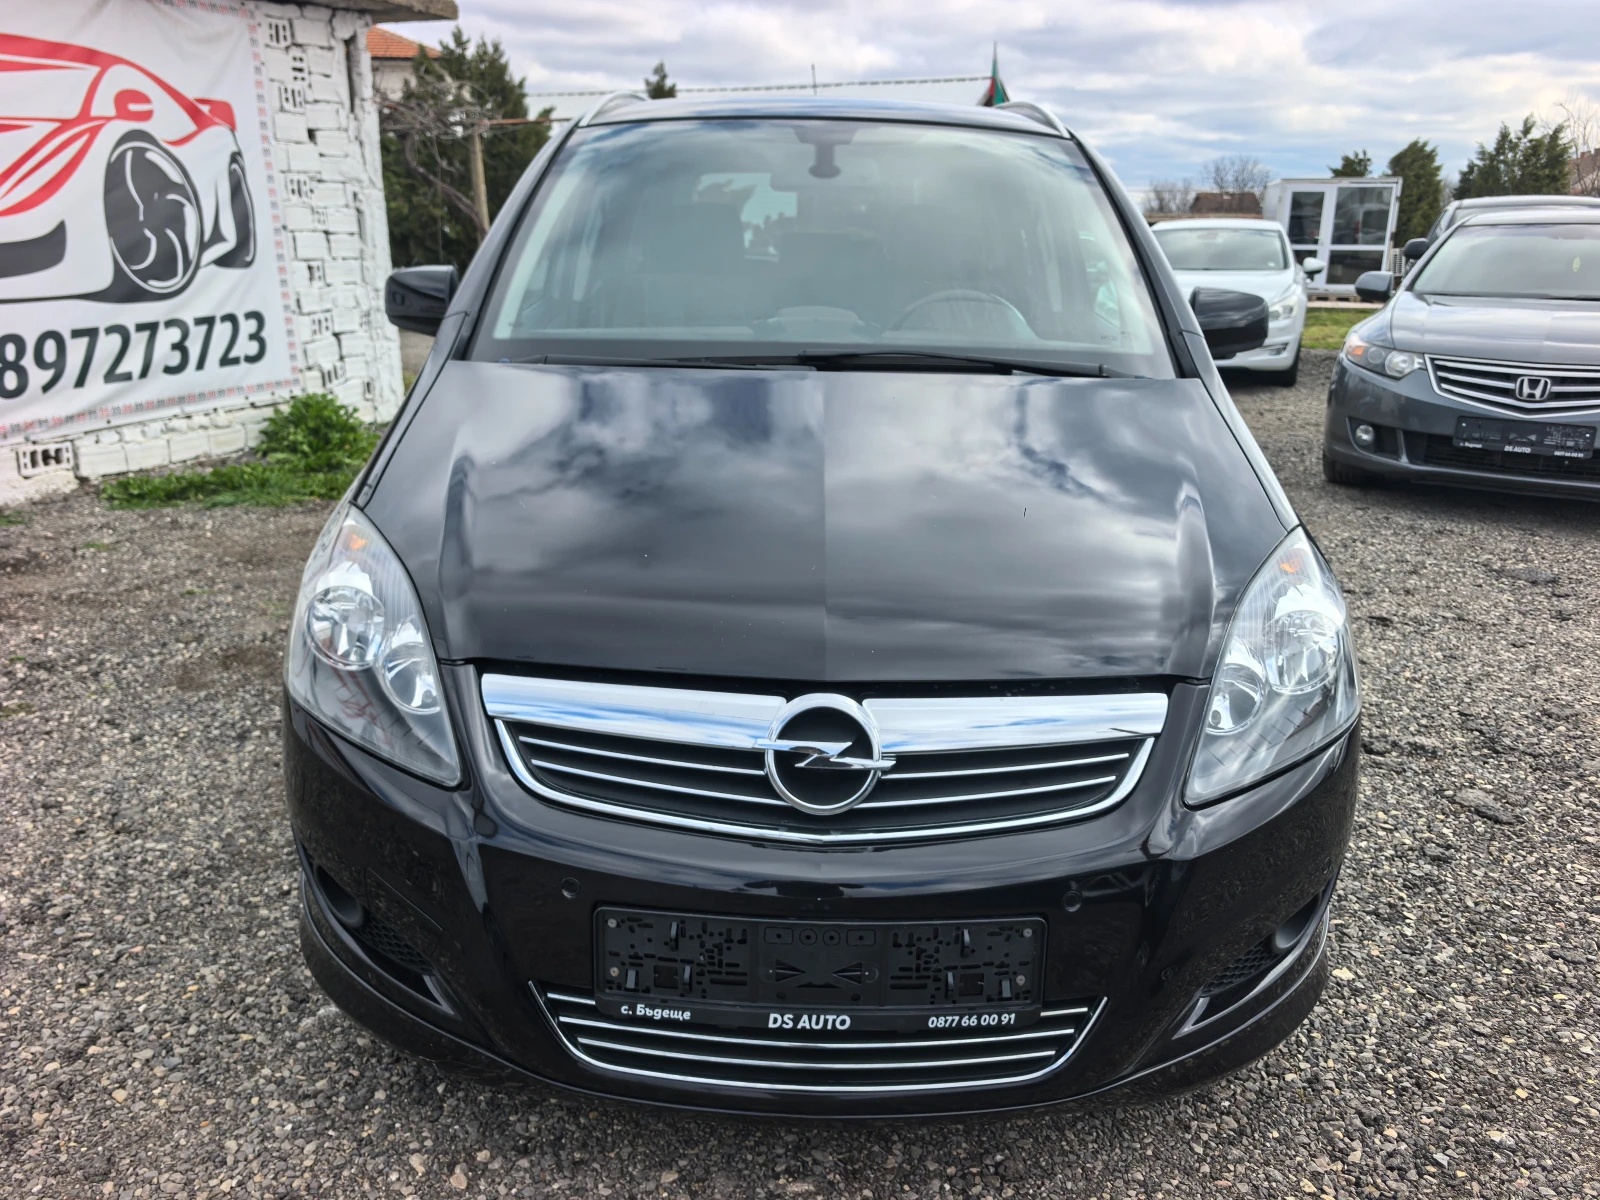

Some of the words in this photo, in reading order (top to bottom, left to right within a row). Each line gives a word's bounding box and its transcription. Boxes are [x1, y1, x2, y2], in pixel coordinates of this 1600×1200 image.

[1513, 446, 1532, 454] AUTO
[620, 1005, 633, 1015] с.
[636, 1003, 692, 1021] Бъдеще
[928, 1015, 960, 1028] 0877
[961, 1014, 978, 1027] 66
[980, 1013, 999, 1026] 00
[1001, 1012, 1016, 1025] 91
[768, 1013, 794, 1029] DS
[796, 1014, 851, 1030] AUTO
